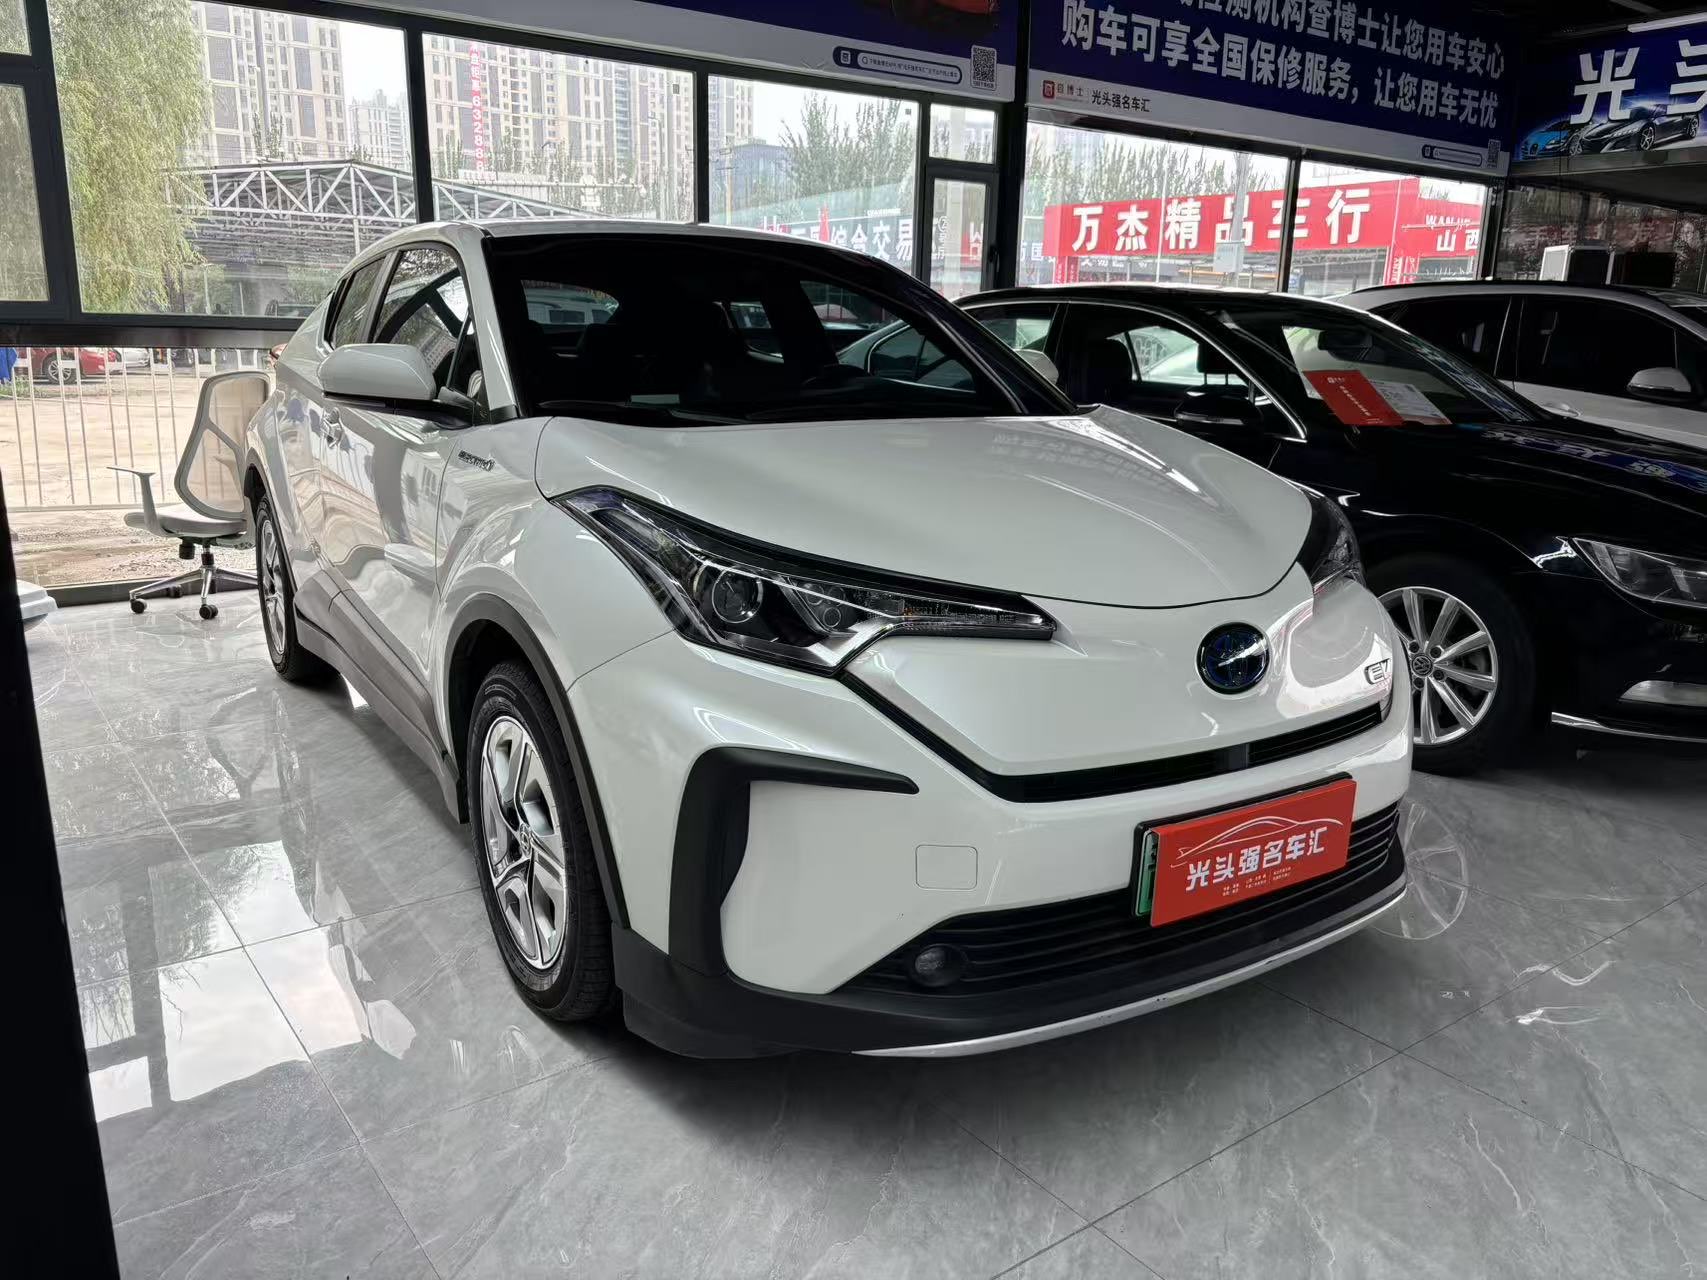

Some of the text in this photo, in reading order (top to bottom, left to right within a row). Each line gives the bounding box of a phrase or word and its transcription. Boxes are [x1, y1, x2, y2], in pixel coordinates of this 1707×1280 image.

[1061, 0, 1499, 129] 购车可享全国保修服务，让您用车无忧
[1181, 0, 1505, 79] 机构查博士让您用车安心
[1091, 90, 1151, 113] 光头强名车汇
[1072, 188, 1371, 252] 万杰精品车行
[1185, 826, 1329, 892] 光头强名车汇
